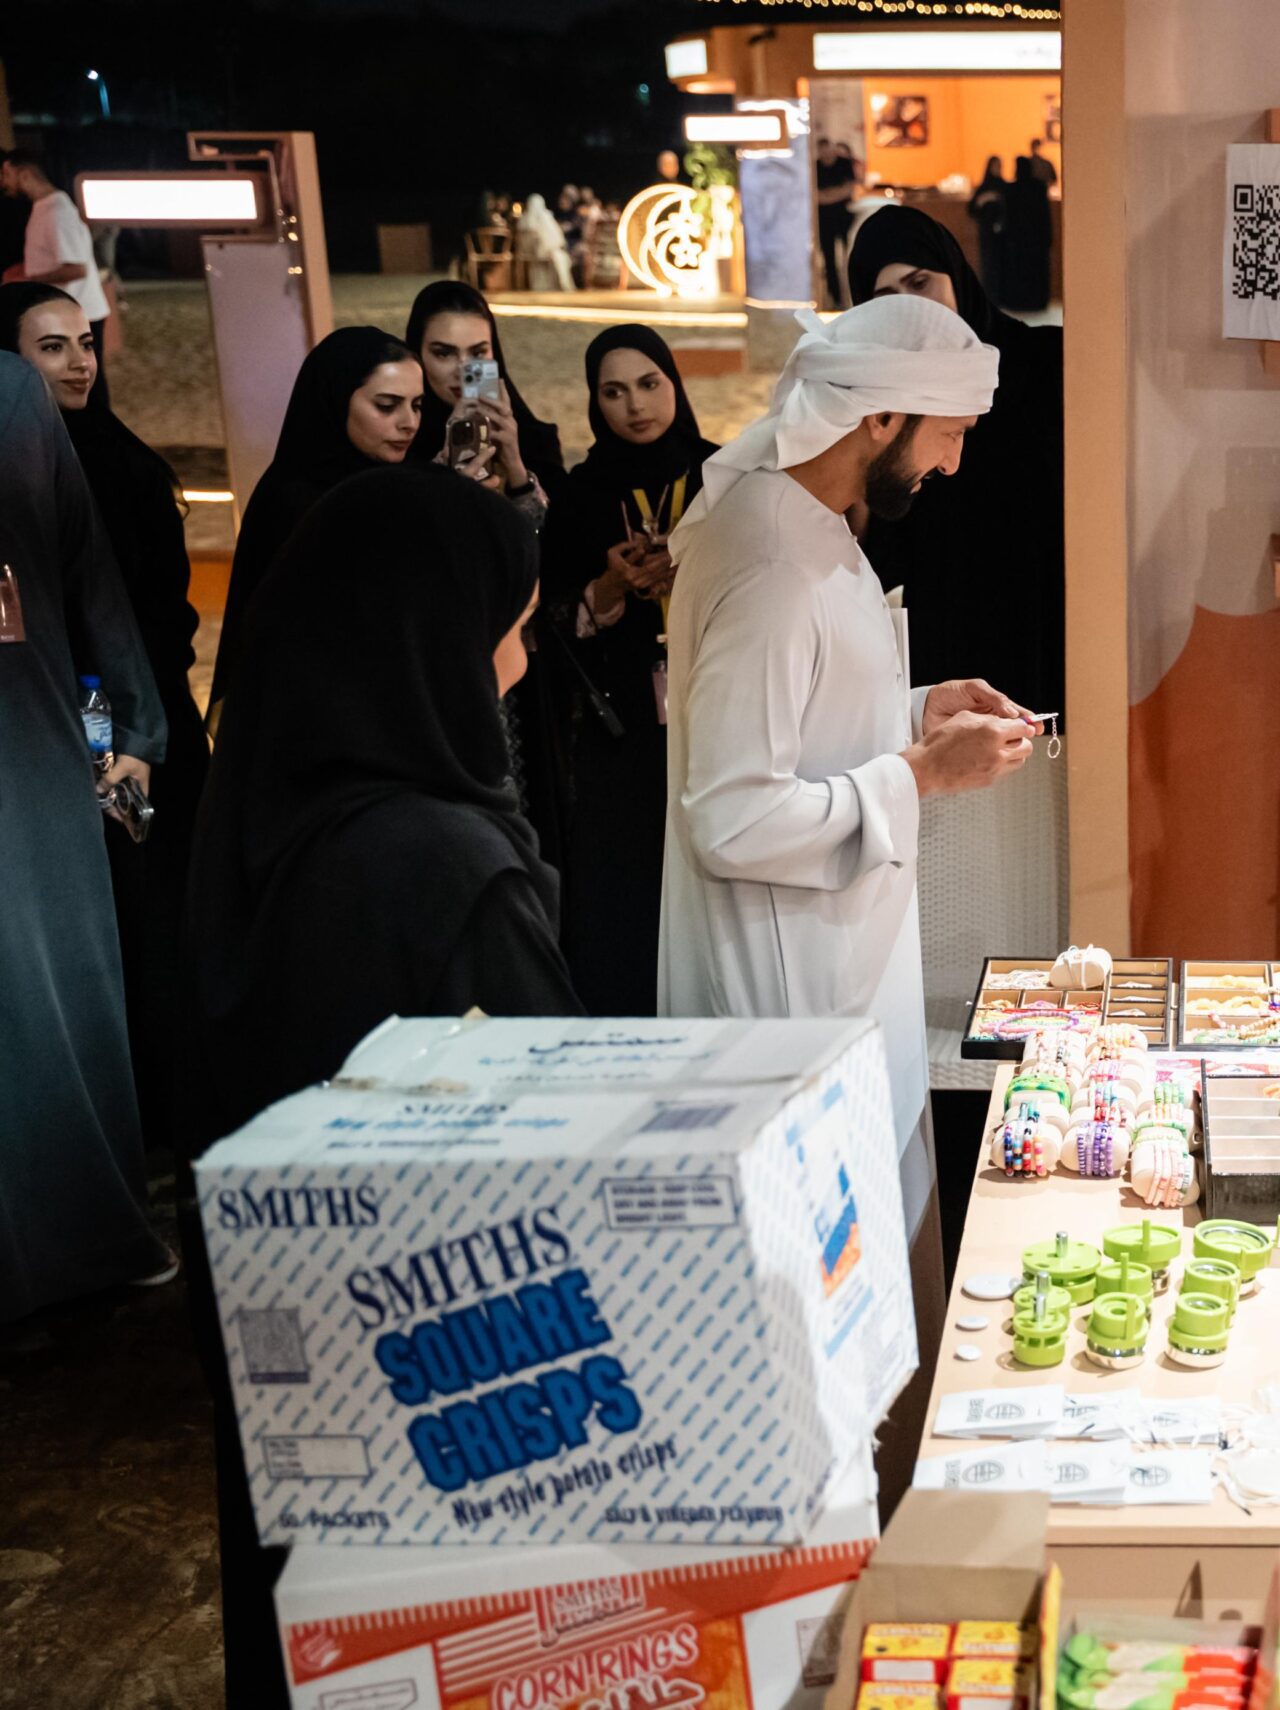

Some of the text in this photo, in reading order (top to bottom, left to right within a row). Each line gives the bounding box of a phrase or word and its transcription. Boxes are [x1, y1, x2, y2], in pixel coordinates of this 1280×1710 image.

[218, 1185, 380, 1230] SMITHS
[346, 1204, 573, 1331] SMITHS
[374, 1267, 614, 1407] SQUARE
[406, 1353, 643, 1493] CRISPS
[550, 1458, 613, 1508] potato
[617, 1435, 678, 1474] crisps
[493, 1622, 699, 1710] CORN RINGS
